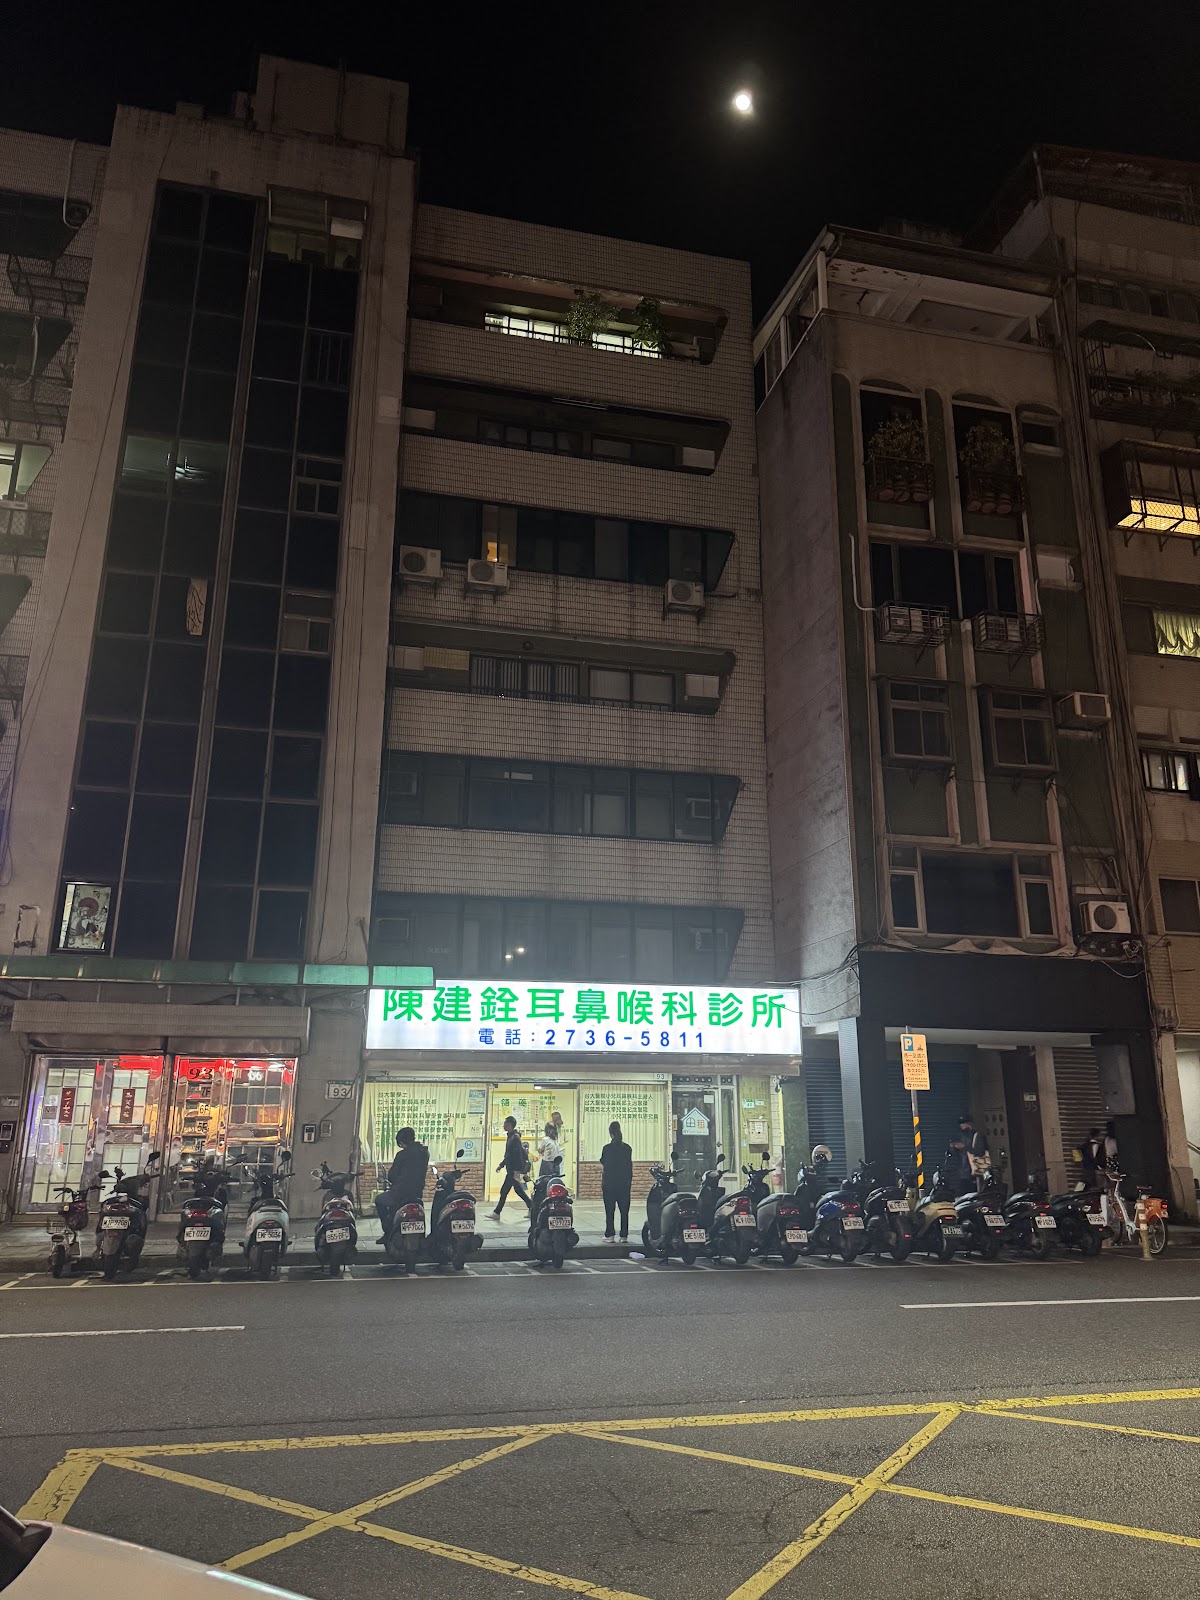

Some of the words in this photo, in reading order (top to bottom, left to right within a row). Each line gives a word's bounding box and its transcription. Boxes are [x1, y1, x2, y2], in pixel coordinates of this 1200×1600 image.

[383, 986, 787, 1029] 陳建銓耳鼻喉科診所
[333, 1087, 347, 1097] 93
